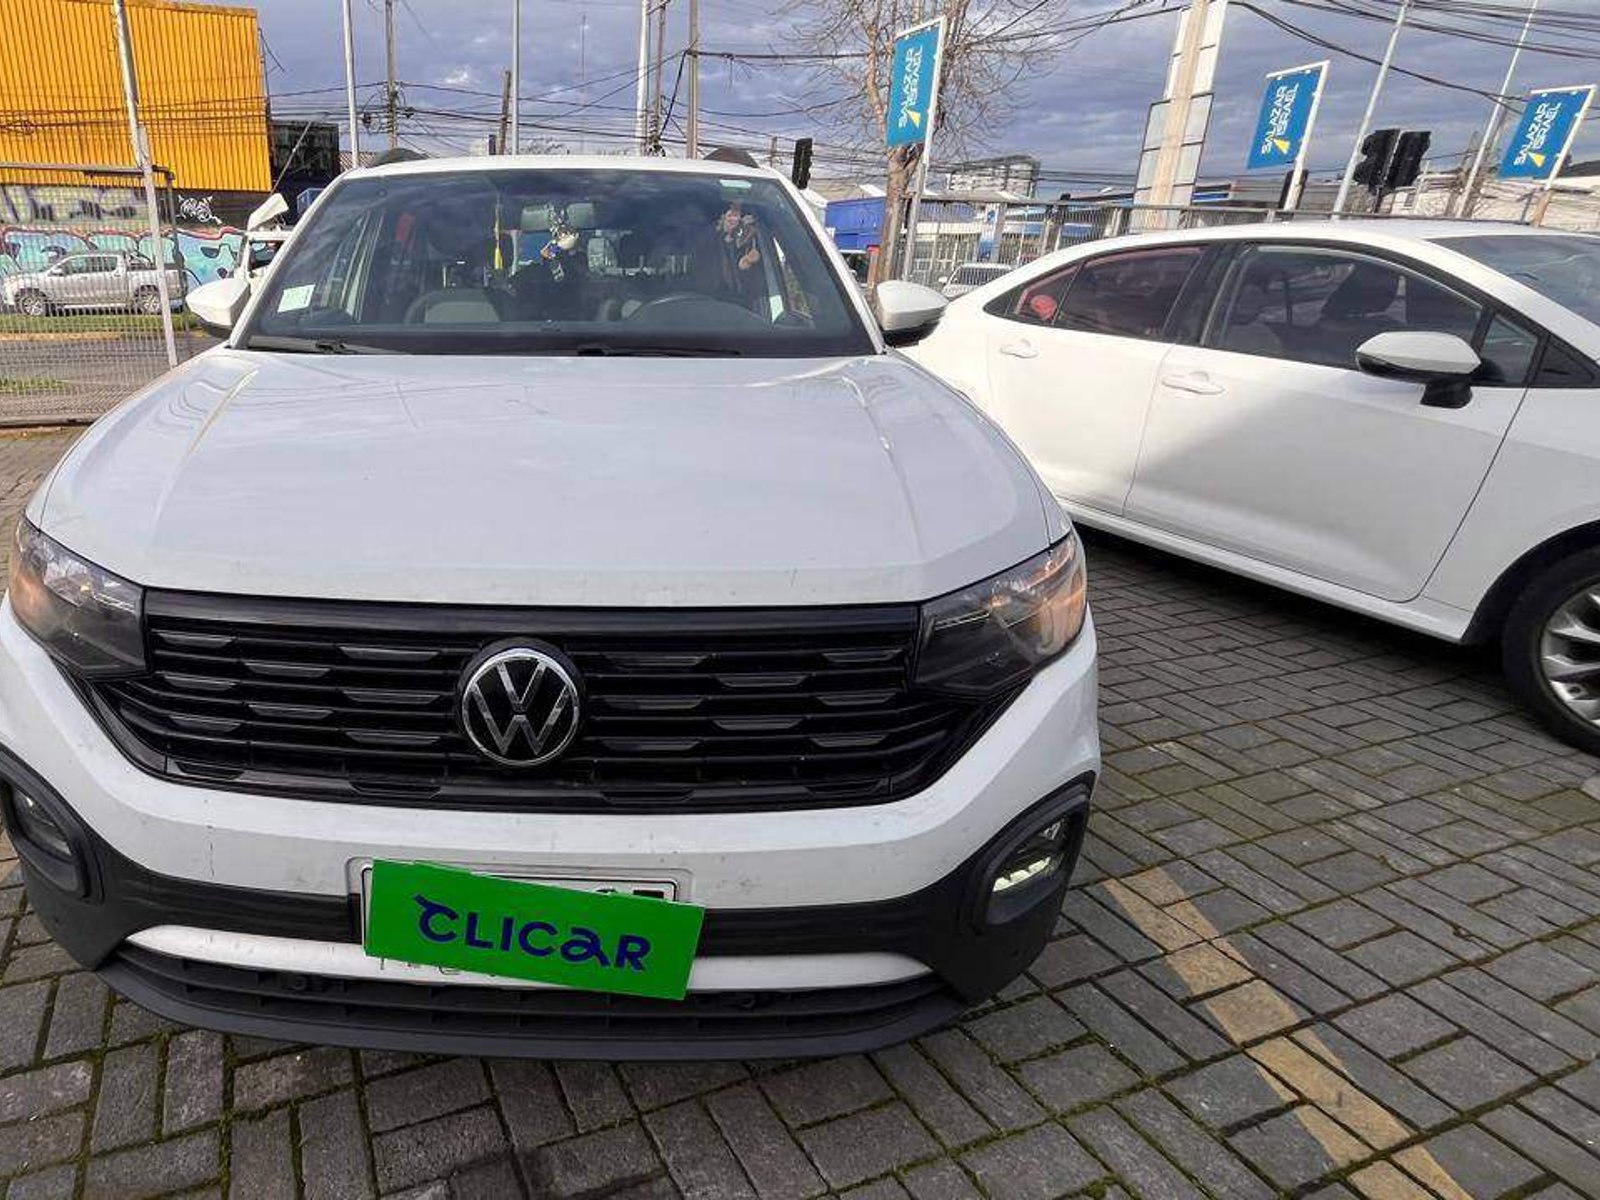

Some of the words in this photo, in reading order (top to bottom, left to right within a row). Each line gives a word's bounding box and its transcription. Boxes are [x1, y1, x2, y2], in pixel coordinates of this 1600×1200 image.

[898, 47, 914, 128] SALAZAR
[908, 44, 922, 106] ISRAEL
[1261, 86, 1287, 154] SALAZAR
[1276, 82, 1299, 135] ISRAEL
[1513, 103, 1549, 166] SALAZAR
[1532, 102, 1562, 149] ISRAEL
